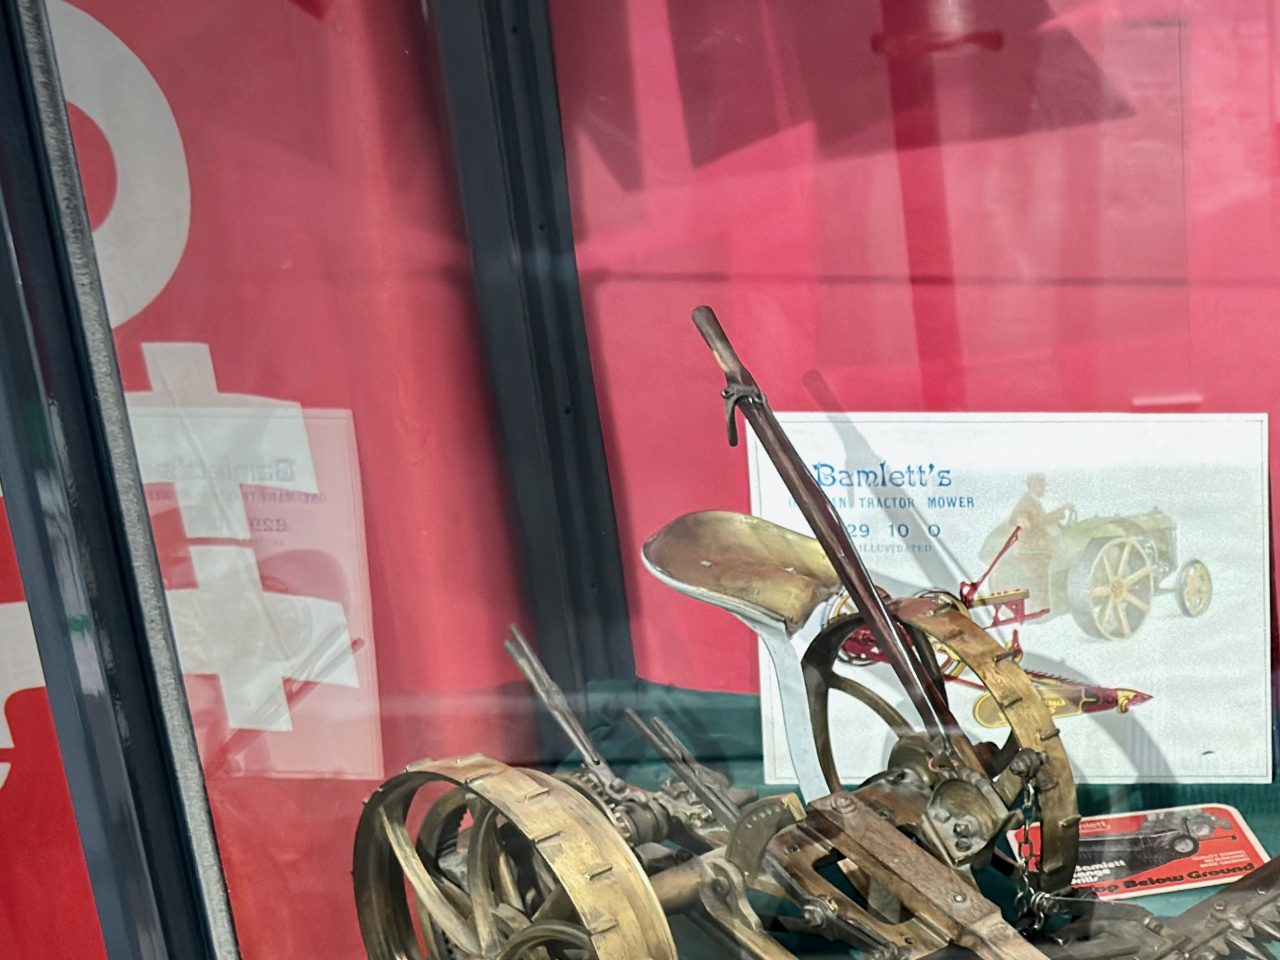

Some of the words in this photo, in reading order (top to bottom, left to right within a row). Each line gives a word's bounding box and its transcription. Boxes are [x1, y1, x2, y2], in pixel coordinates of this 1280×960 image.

[813, 460, 952, 487] Bamlett's
[859, 497, 915, 509] TRACTOR
[927, 496, 975, 509] MOWER
[889, 523, 910, 538] 10
[1123, 873, 1184, 889] Below
[1187, 863, 1255, 879] Ground
